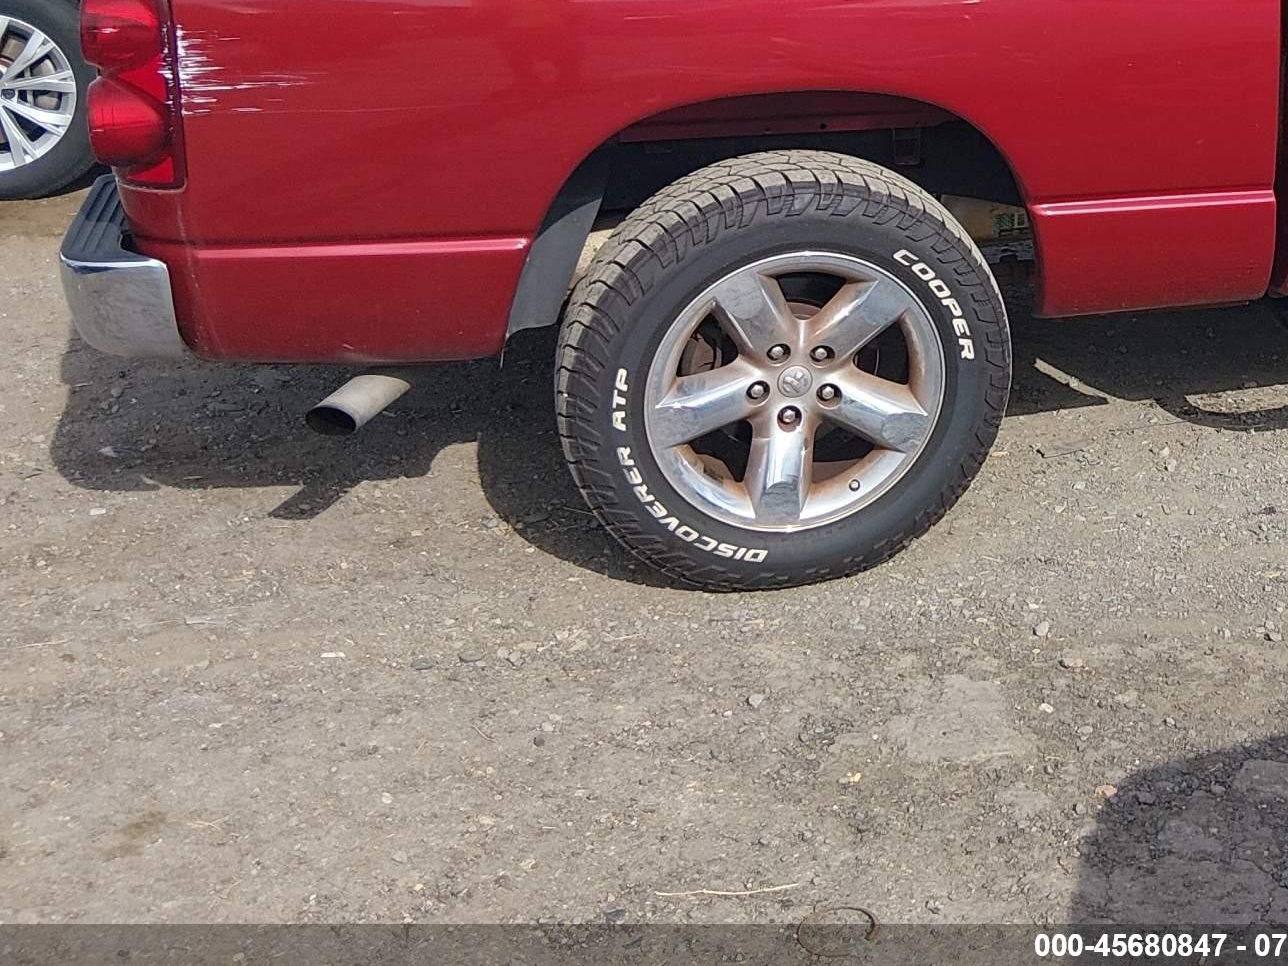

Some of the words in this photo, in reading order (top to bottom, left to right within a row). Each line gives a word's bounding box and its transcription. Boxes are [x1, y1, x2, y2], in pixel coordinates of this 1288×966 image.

[893, 249, 975, 360] COOPER
[612, 368, 628, 432] ATP
[616, 446, 769, 563] DISCOVERER
